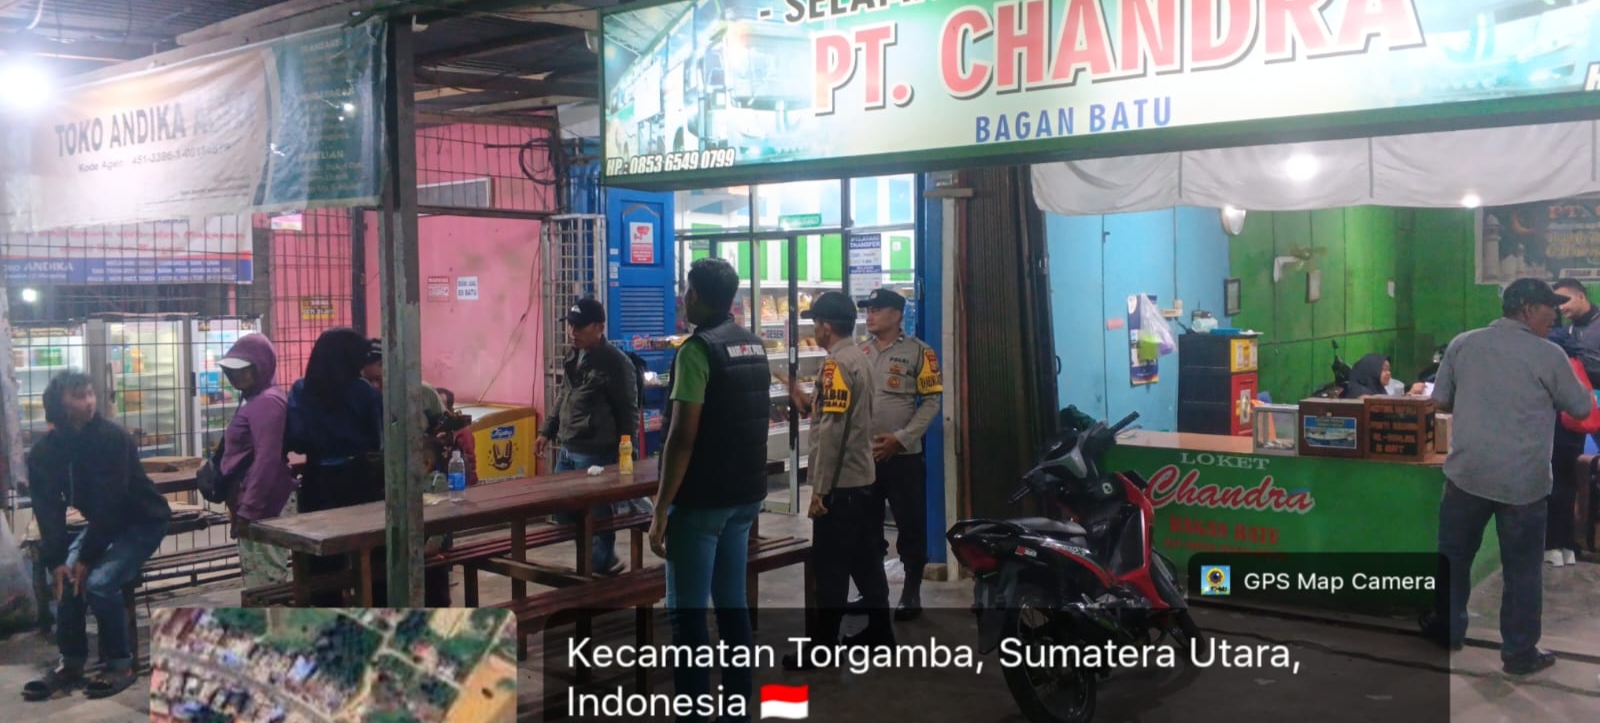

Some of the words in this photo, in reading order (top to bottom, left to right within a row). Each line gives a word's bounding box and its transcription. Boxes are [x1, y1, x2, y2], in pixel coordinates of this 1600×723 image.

[811, 22, 915, 117] PT.
[939, 0, 1428, 101] CHANDRA
[56, 117, 104, 158] TOKO
[110, 103, 187, 149] ANDIKA
[975, 112, 1076, 142] BAGAN
[1088, 96, 1172, 133] BATU
[630, 157, 663, 175] 0853
[664, 152, 700, 172] 6549
[700, 147, 736, 169] 0799
[767, 329, 785, 339] GESER
[889, 356, 910, 364] POLRI
[1180, 452, 1271, 470] LOKET
[1146, 464, 1316, 514] Chandra
[1169, 517, 1229, 539] BAGAN
[1234, 523, 1280, 546] BATU
